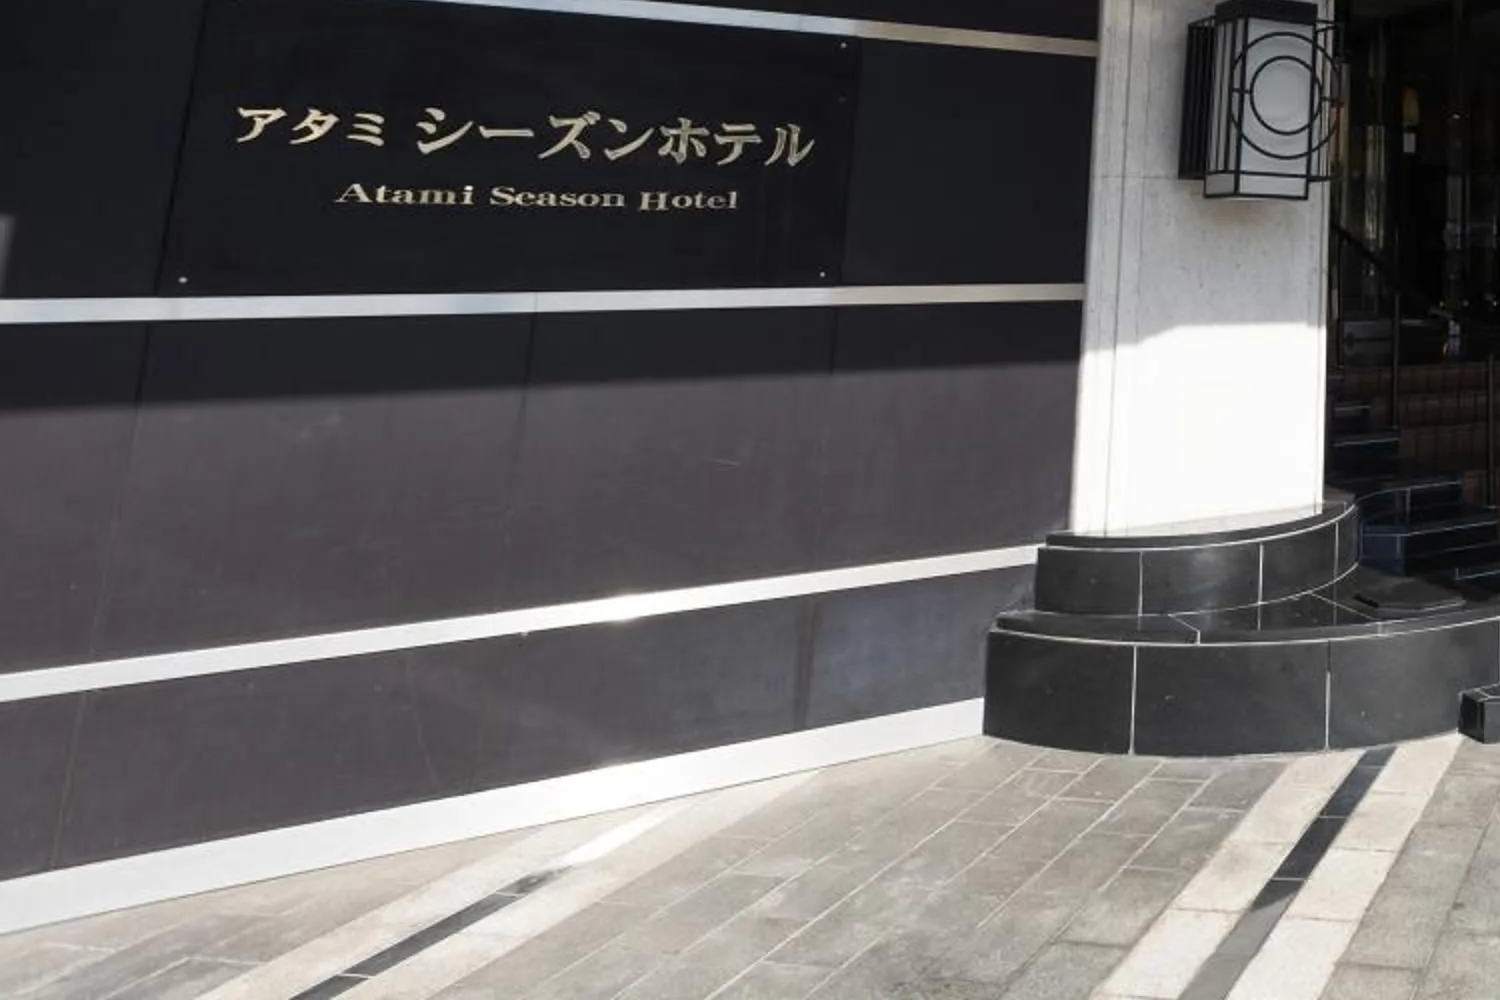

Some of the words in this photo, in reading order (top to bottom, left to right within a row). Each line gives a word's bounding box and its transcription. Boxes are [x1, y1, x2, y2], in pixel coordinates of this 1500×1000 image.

[335, 183, 474, 205] Atami
[489, 186, 625, 208] Season
[639, 191, 738, 211] Hotel
